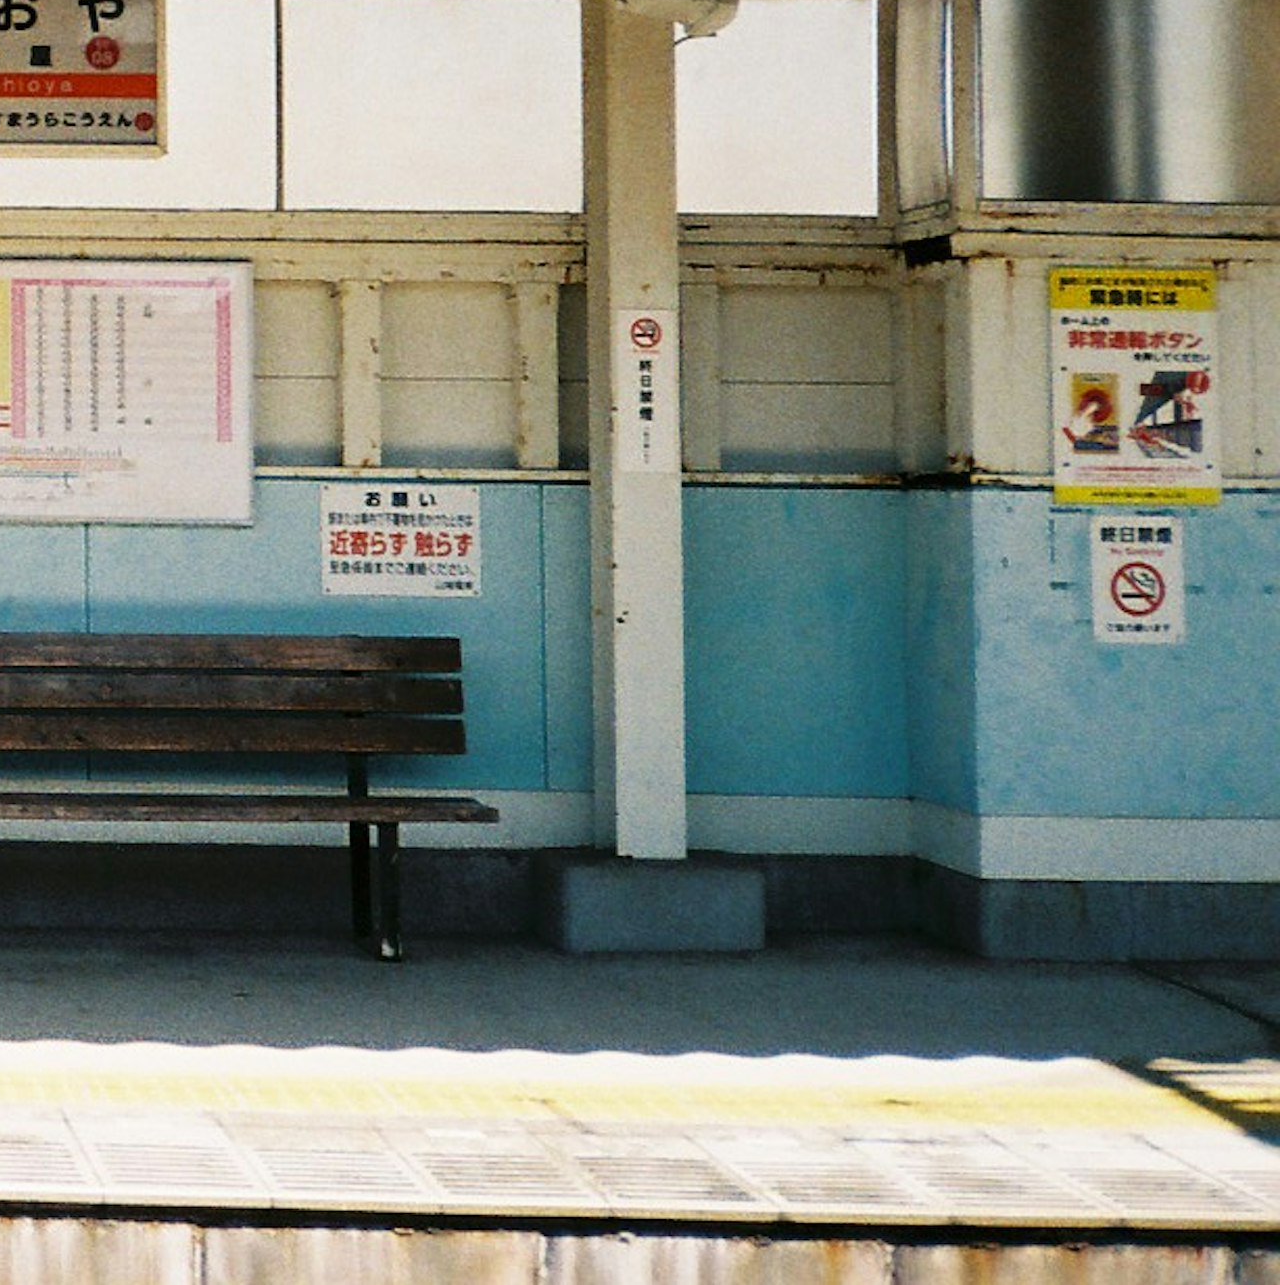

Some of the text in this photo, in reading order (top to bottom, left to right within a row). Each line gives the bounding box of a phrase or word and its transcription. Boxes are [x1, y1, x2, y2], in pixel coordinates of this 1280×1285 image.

[365, 492, 437, 508] お願い
[1101, 527, 1172, 543] 終日禁煙
[330, 530, 473, 557] 近寄らず 触らず
